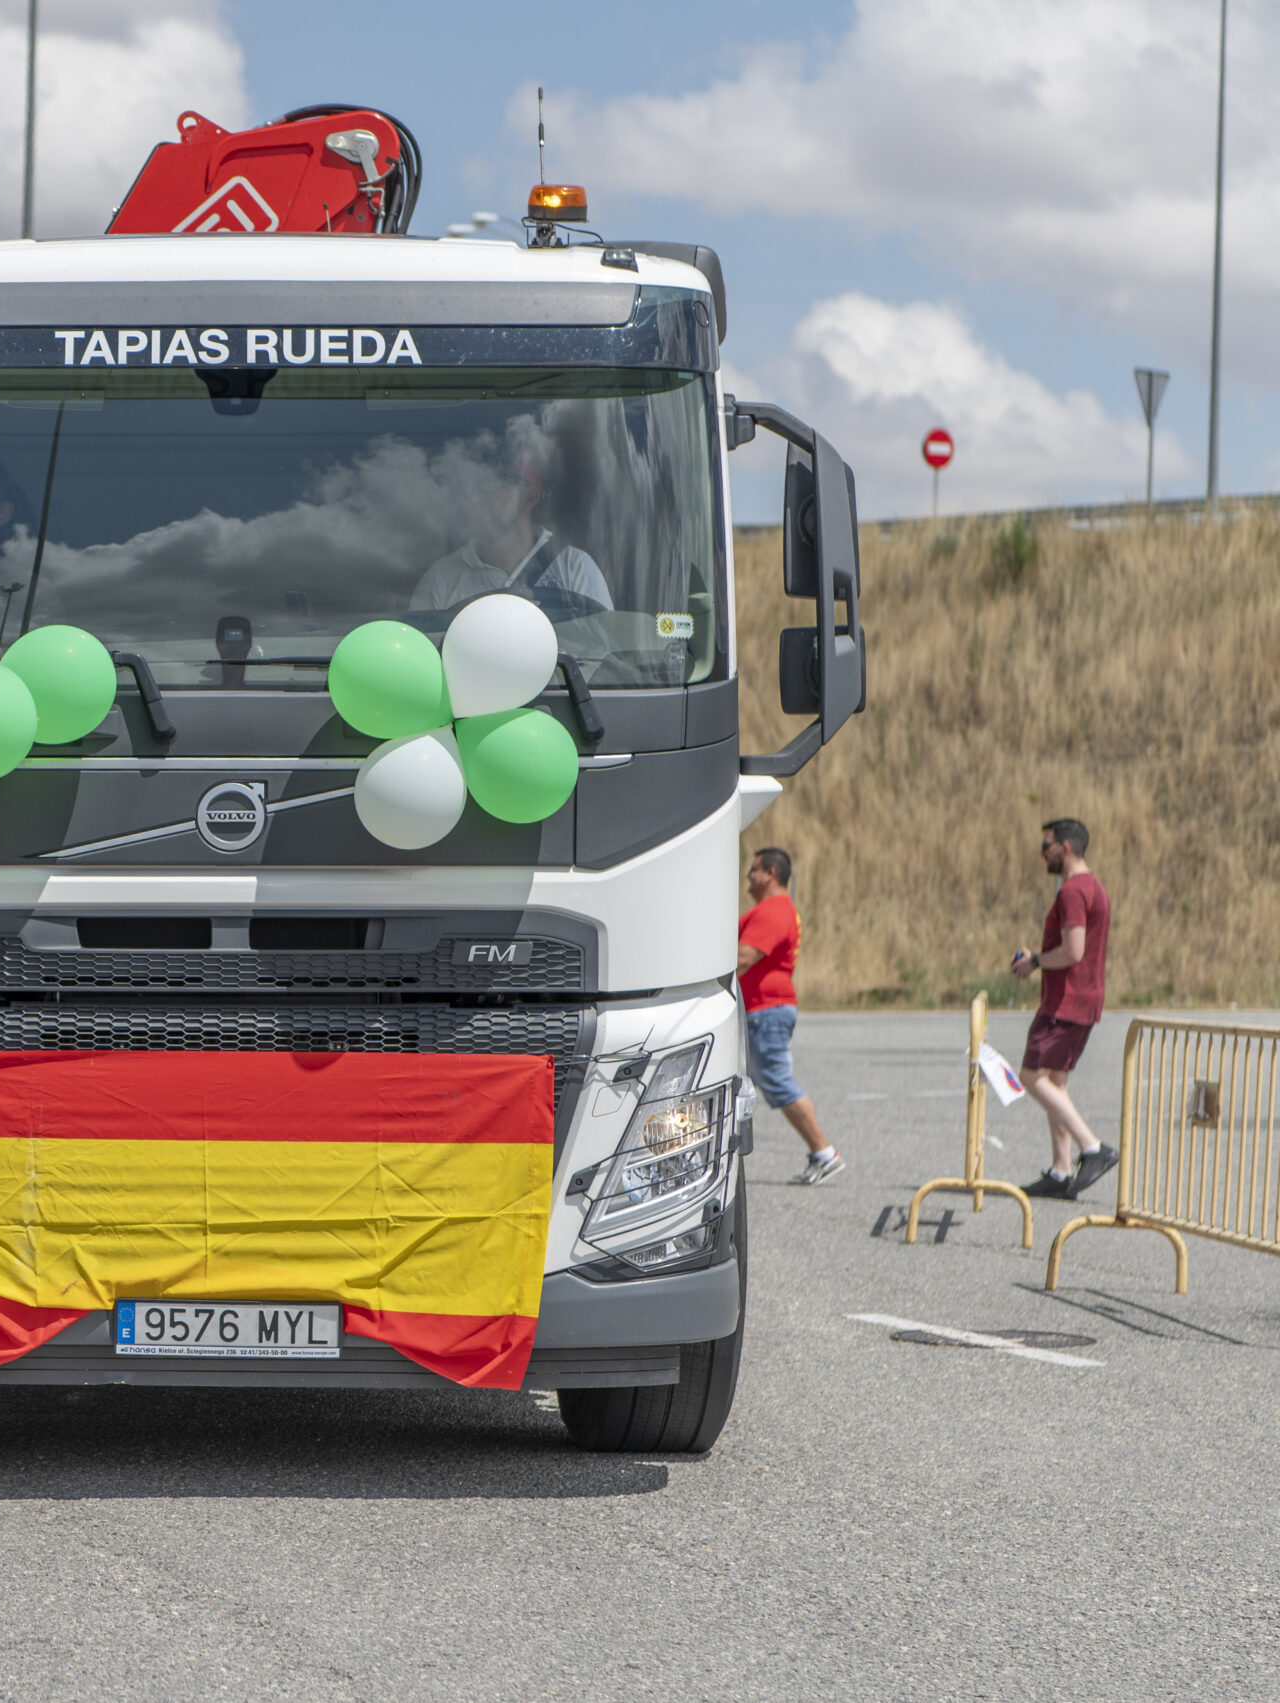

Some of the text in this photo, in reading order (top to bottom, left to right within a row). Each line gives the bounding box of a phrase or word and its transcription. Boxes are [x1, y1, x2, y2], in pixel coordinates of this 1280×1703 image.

[55, 328, 423, 366] TAPIAS RUEDA
[206, 812, 256, 821] VOLVO
[467, 944, 517, 963] FM
[122, 1328, 131, 1338] E
[144, 1307, 329, 1345] 9576 MYL
